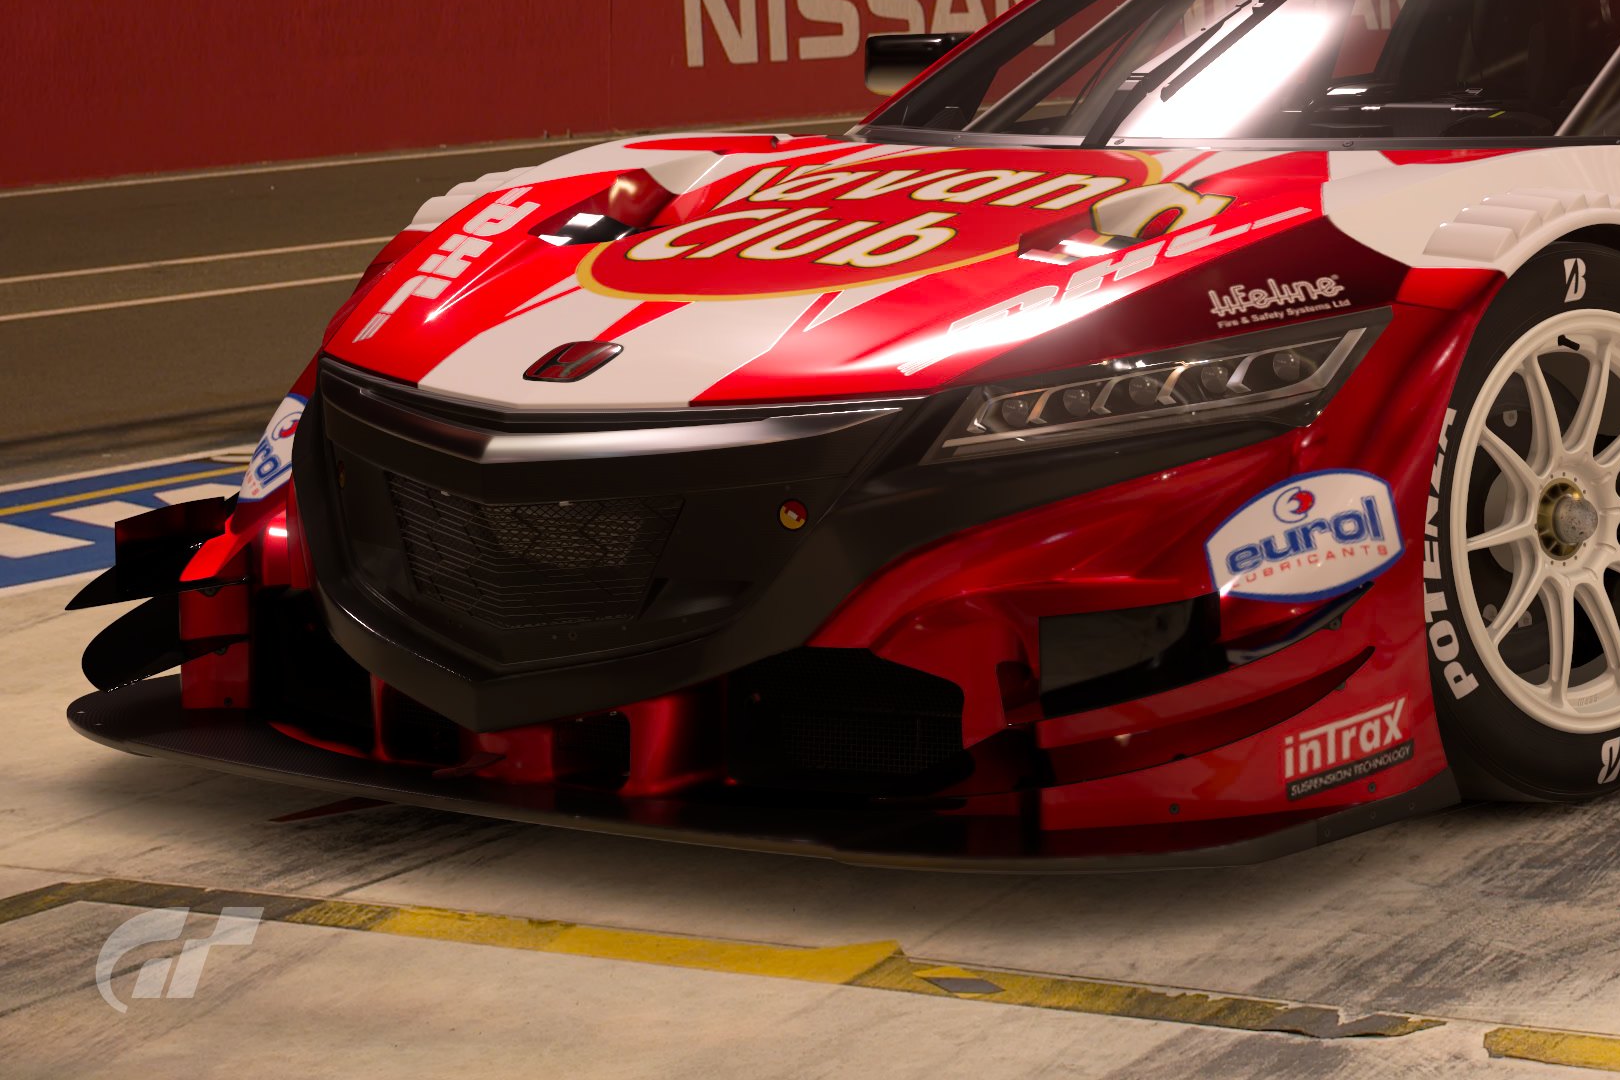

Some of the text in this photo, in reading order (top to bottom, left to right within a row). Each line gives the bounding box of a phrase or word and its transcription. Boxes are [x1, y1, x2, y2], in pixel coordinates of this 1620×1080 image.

[625, 207, 957, 269] Club
[1217, 319, 1240, 329] Fire
[1240, 316, 1251, 326] &
[1251, 309, 1286, 323] Safety
[1286, 302, 1332, 319] Systems
[1225, 494, 1385, 576] eurol
[1424, 406, 1480, 700] POTENZA
[1290, 765, 1353, 797] SUSPENSION
